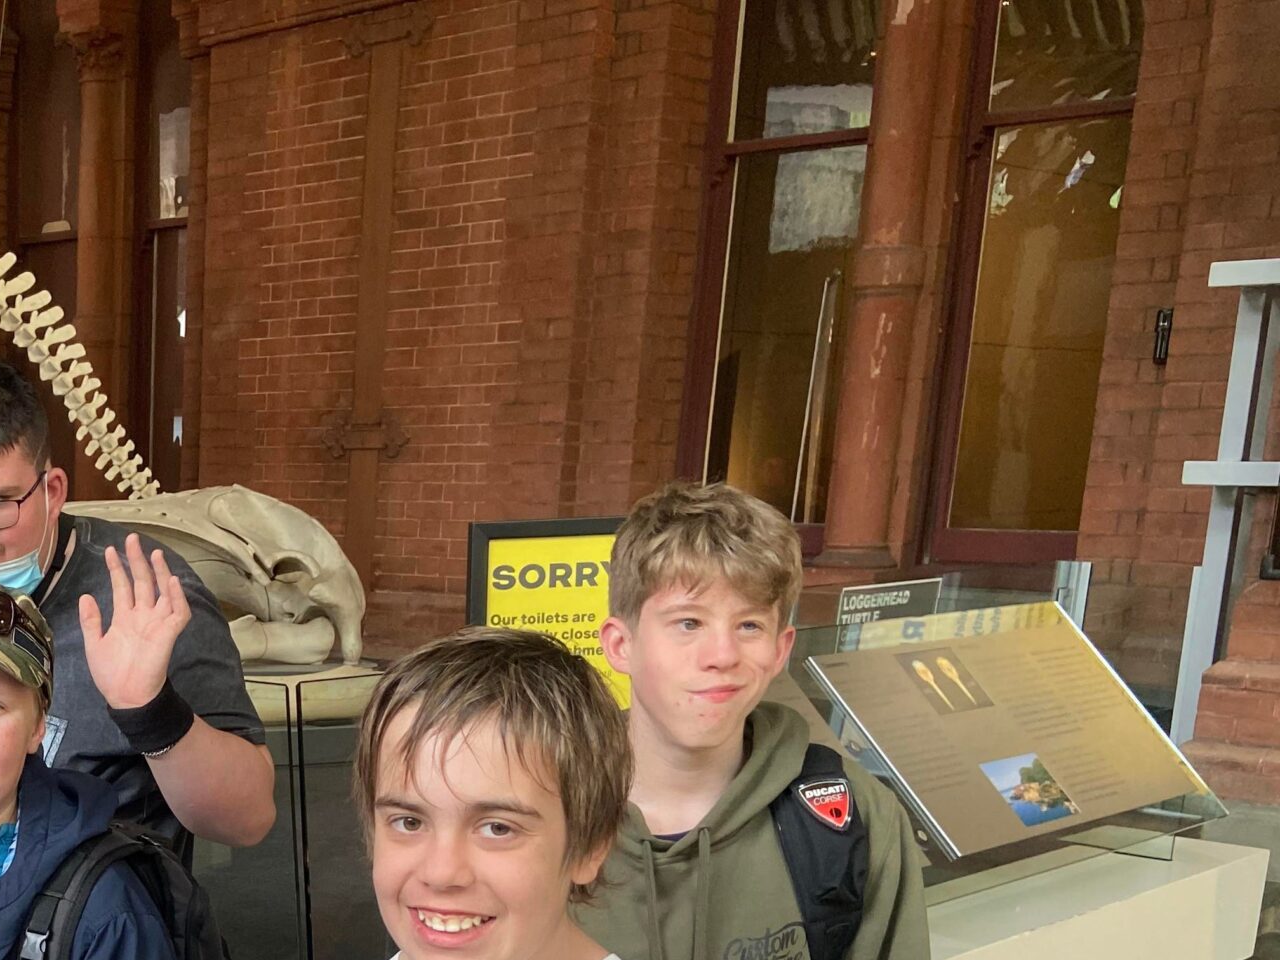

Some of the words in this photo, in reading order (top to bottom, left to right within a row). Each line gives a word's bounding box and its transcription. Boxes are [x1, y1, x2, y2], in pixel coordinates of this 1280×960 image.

[843, 590, 911, 611] LOGGERHEAD
[490, 614, 517, 626] Our
[521, 612, 569, 625] toilets
[572, 612, 596, 623] are
[561, 628, 599, 640] close
[804, 784, 845, 799] DUCATI
[813, 794, 844, 806] CORSE
